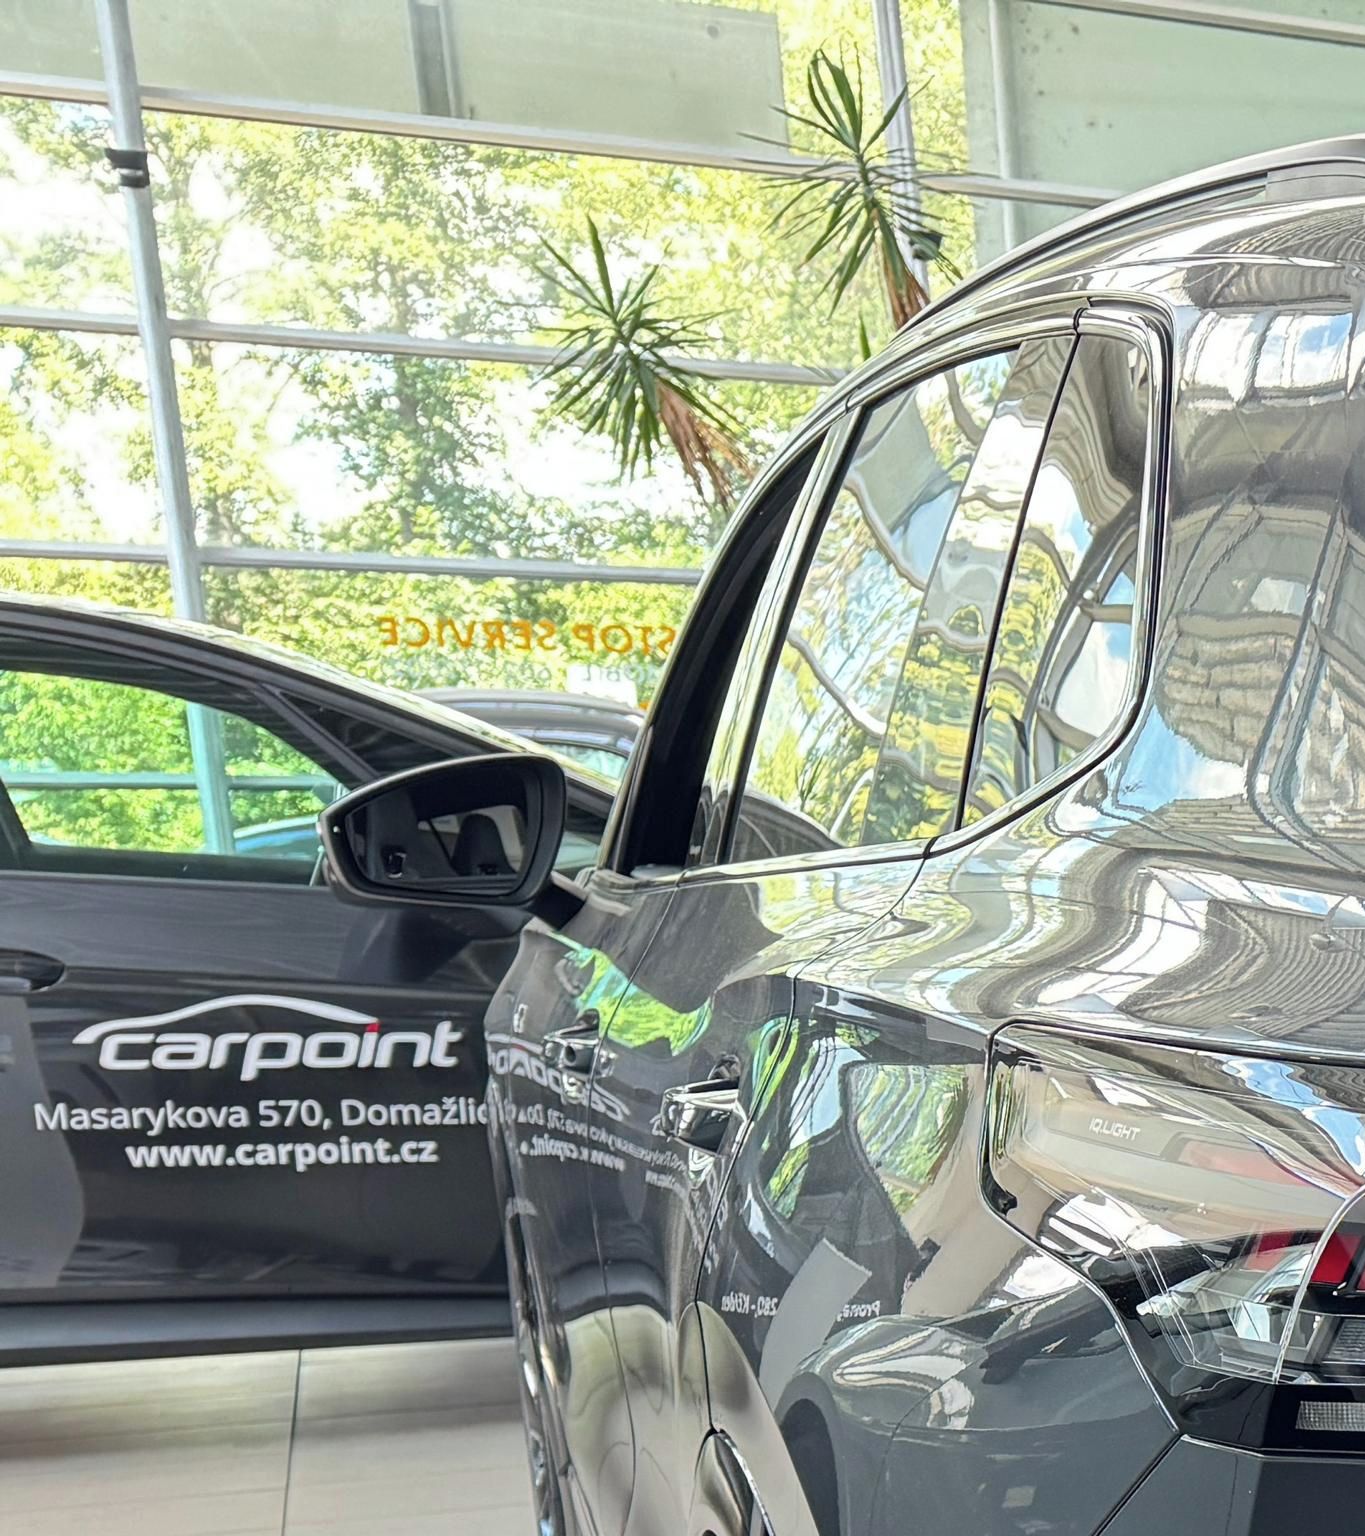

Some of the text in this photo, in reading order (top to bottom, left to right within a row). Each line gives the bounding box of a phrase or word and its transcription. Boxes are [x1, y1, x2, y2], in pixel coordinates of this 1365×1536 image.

[98, 1019, 465, 1082] carpoint
[33, 1096, 488, 1137] Masarykova 570, Domažlic
[1088, 1117, 1141, 1141] IQ.LIGHT
[124, 1136, 440, 1172] www.carpoint.cz
